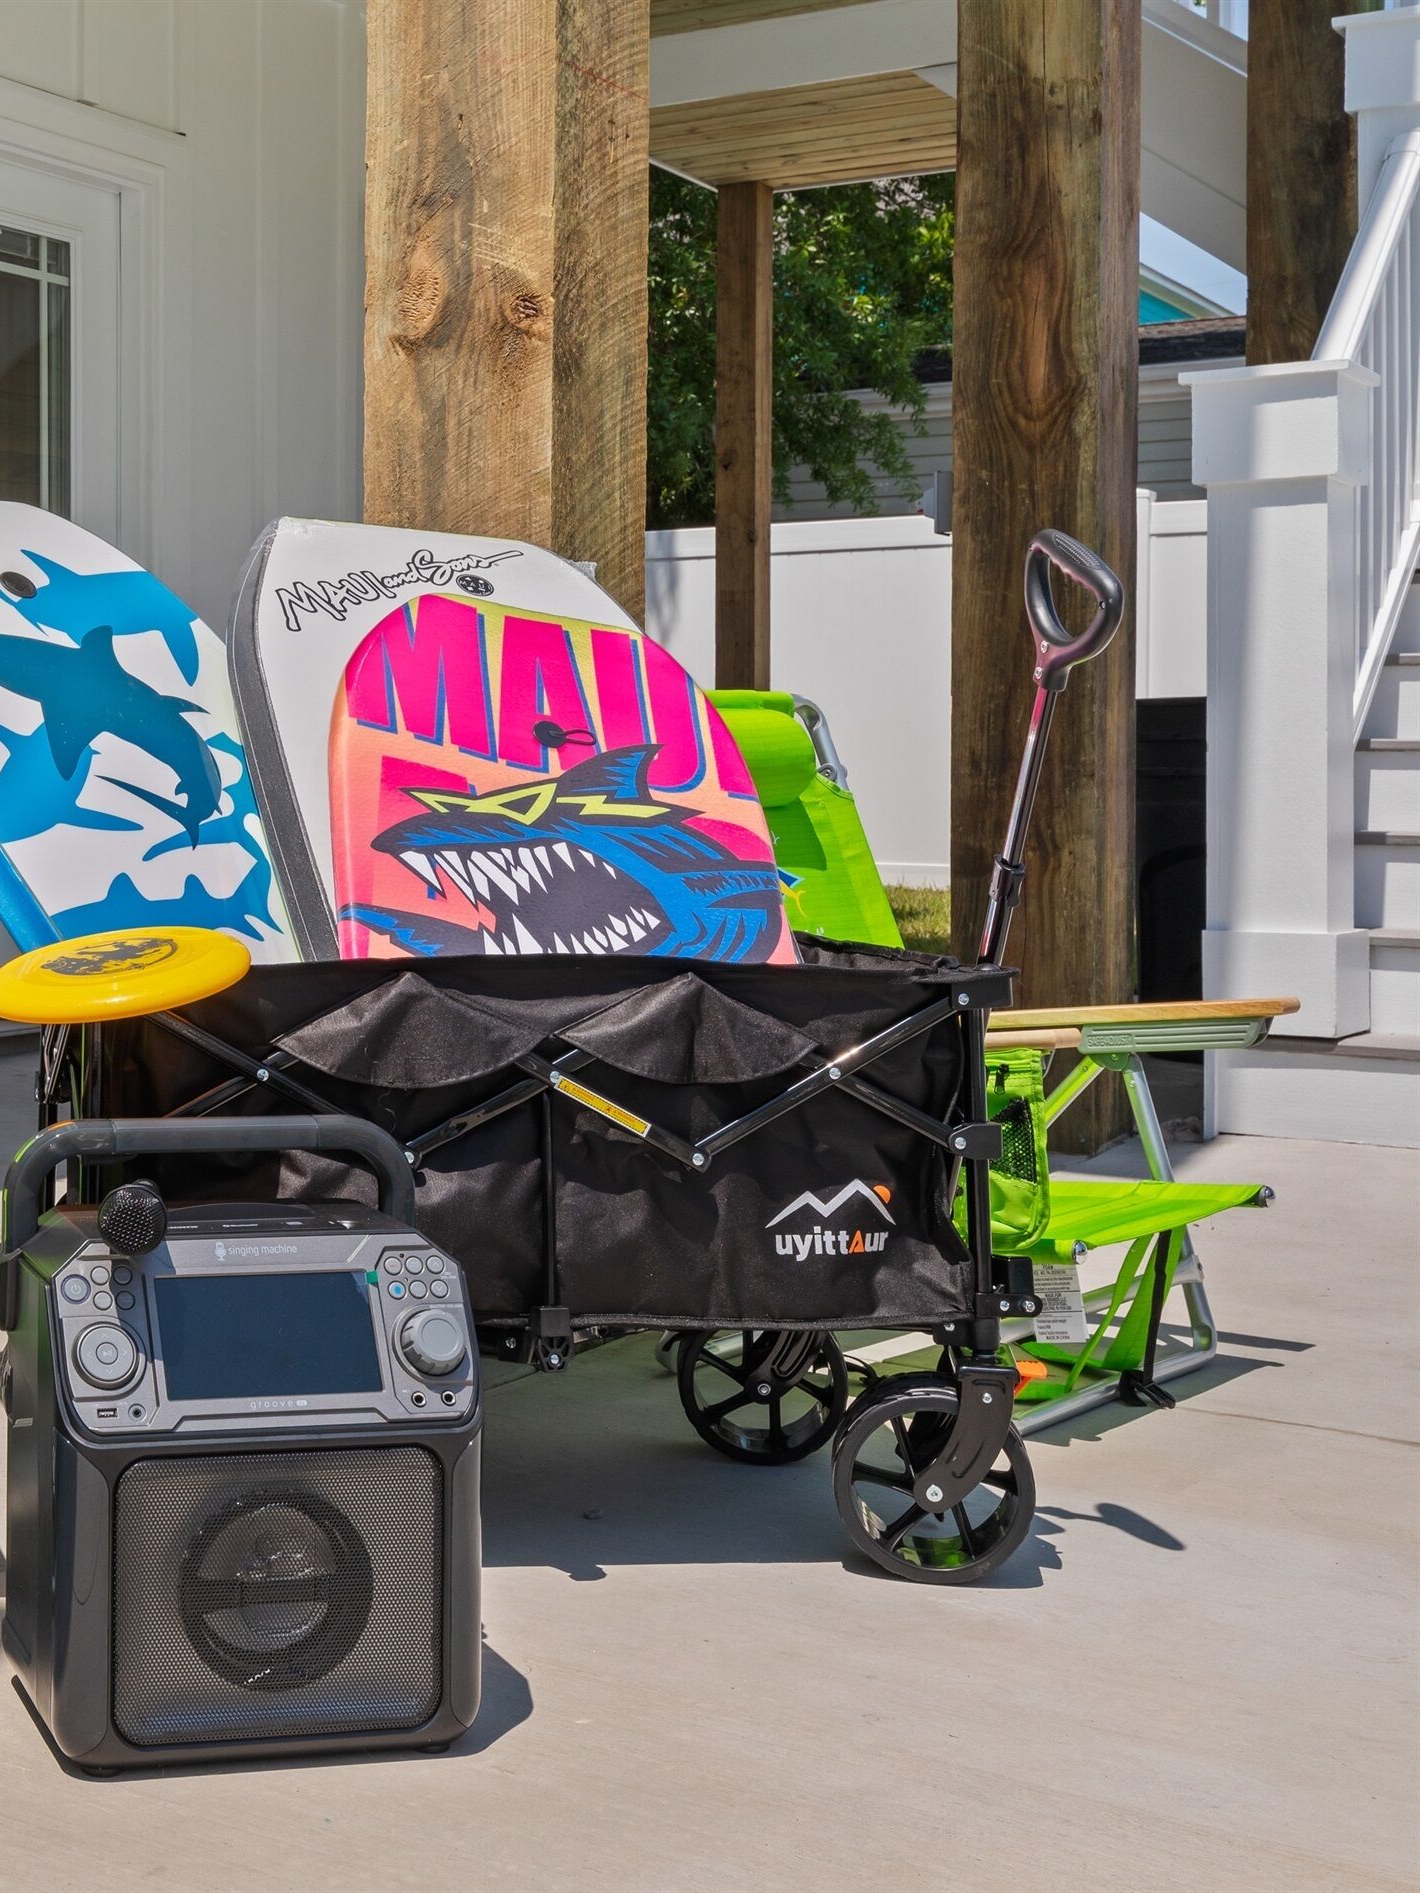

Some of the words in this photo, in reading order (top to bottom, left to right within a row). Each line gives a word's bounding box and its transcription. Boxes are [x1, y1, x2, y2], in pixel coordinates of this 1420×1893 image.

[276, 570, 396, 632] MAUI
[383, 563, 425, 589] and
[412, 549, 524, 586] Sons
[228, 1244, 259, 1257] singing
[261, 1243, 298, 1254] machine
[250, 1399, 293, 1411] groove
